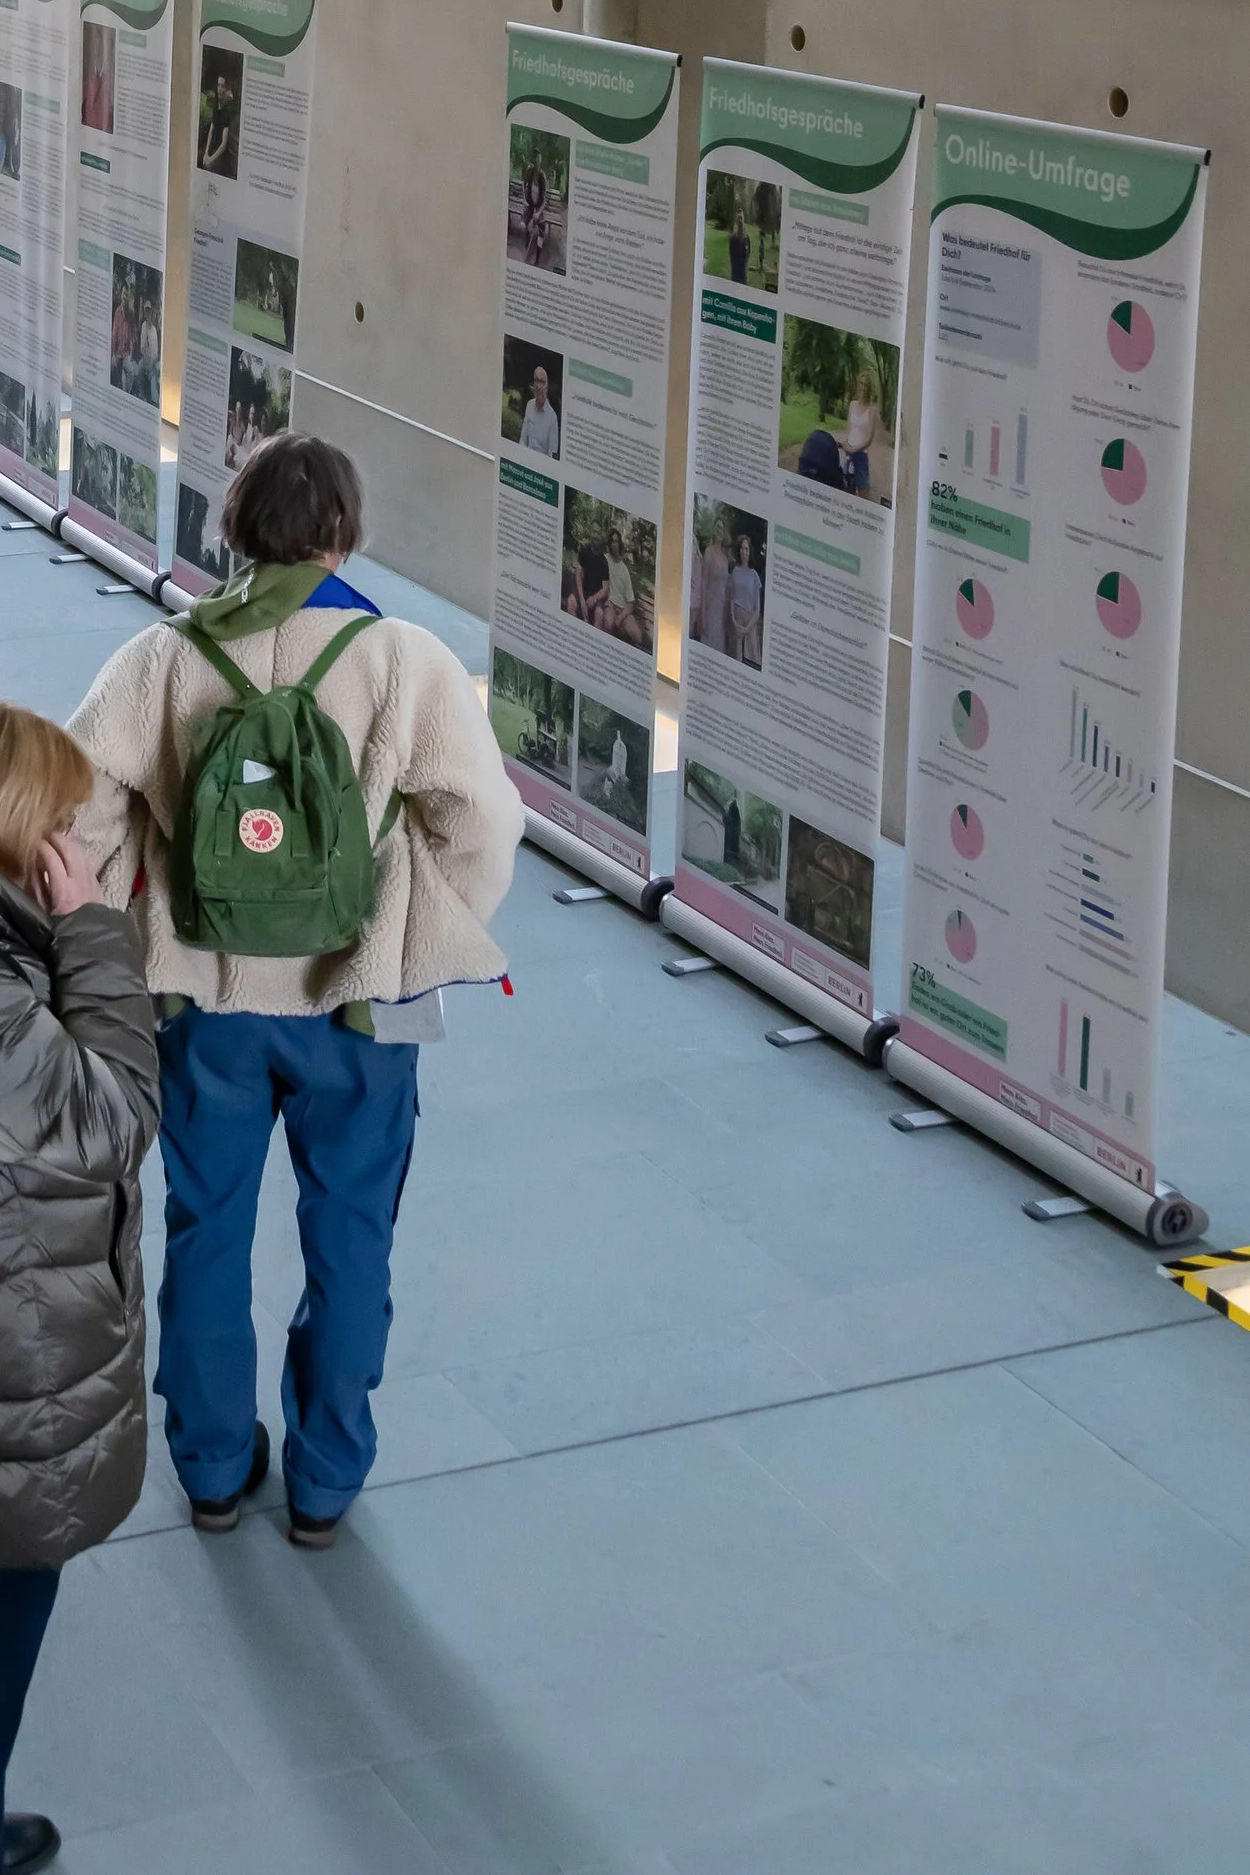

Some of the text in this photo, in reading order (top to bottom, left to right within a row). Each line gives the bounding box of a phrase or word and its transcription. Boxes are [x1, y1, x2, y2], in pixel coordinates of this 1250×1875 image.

[512, 49, 635, 94] Friedhofsgespräche
[709, 86, 864, 139] Friedhofsgespräche
[945, 134, 1131, 203] Online-Umfrage
[942, 232, 1031, 262] Was bedeutet Friedhof für
[942, 247, 961, 260] Dich?
[702, 297, 713, 305] mit
[743, 320, 758, 334] Baby
[931, 480, 958, 502] 82%
[931, 499, 954, 516] haben
[955, 511, 973, 523] einen
[974, 515, 1003, 533] Friedhof
[827, 975, 851, 997] BERLIN
[912, 961, 936, 989] 73%
[1096, 1145, 1127, 1172] BERLIN
